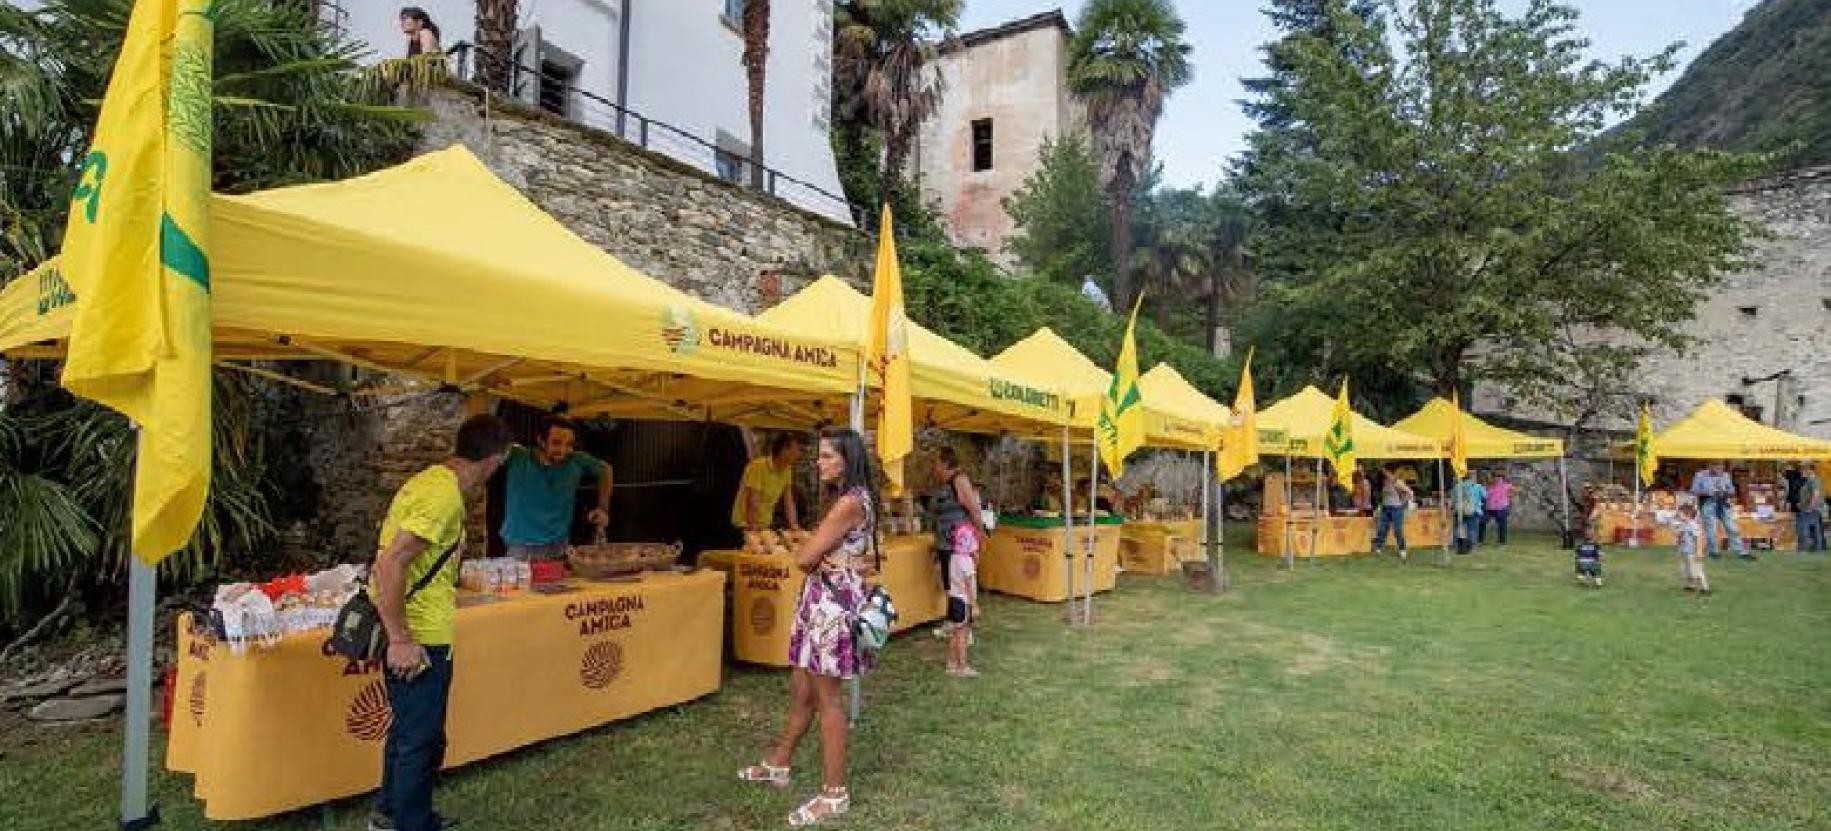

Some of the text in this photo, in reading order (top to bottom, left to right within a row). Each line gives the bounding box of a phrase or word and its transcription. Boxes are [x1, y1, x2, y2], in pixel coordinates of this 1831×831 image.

[708, 328, 837, 368] CAMPAGNA AMICA
[565, 595, 645, 620] CAMPAGNA
[579, 614, 632, 636] AMICA
